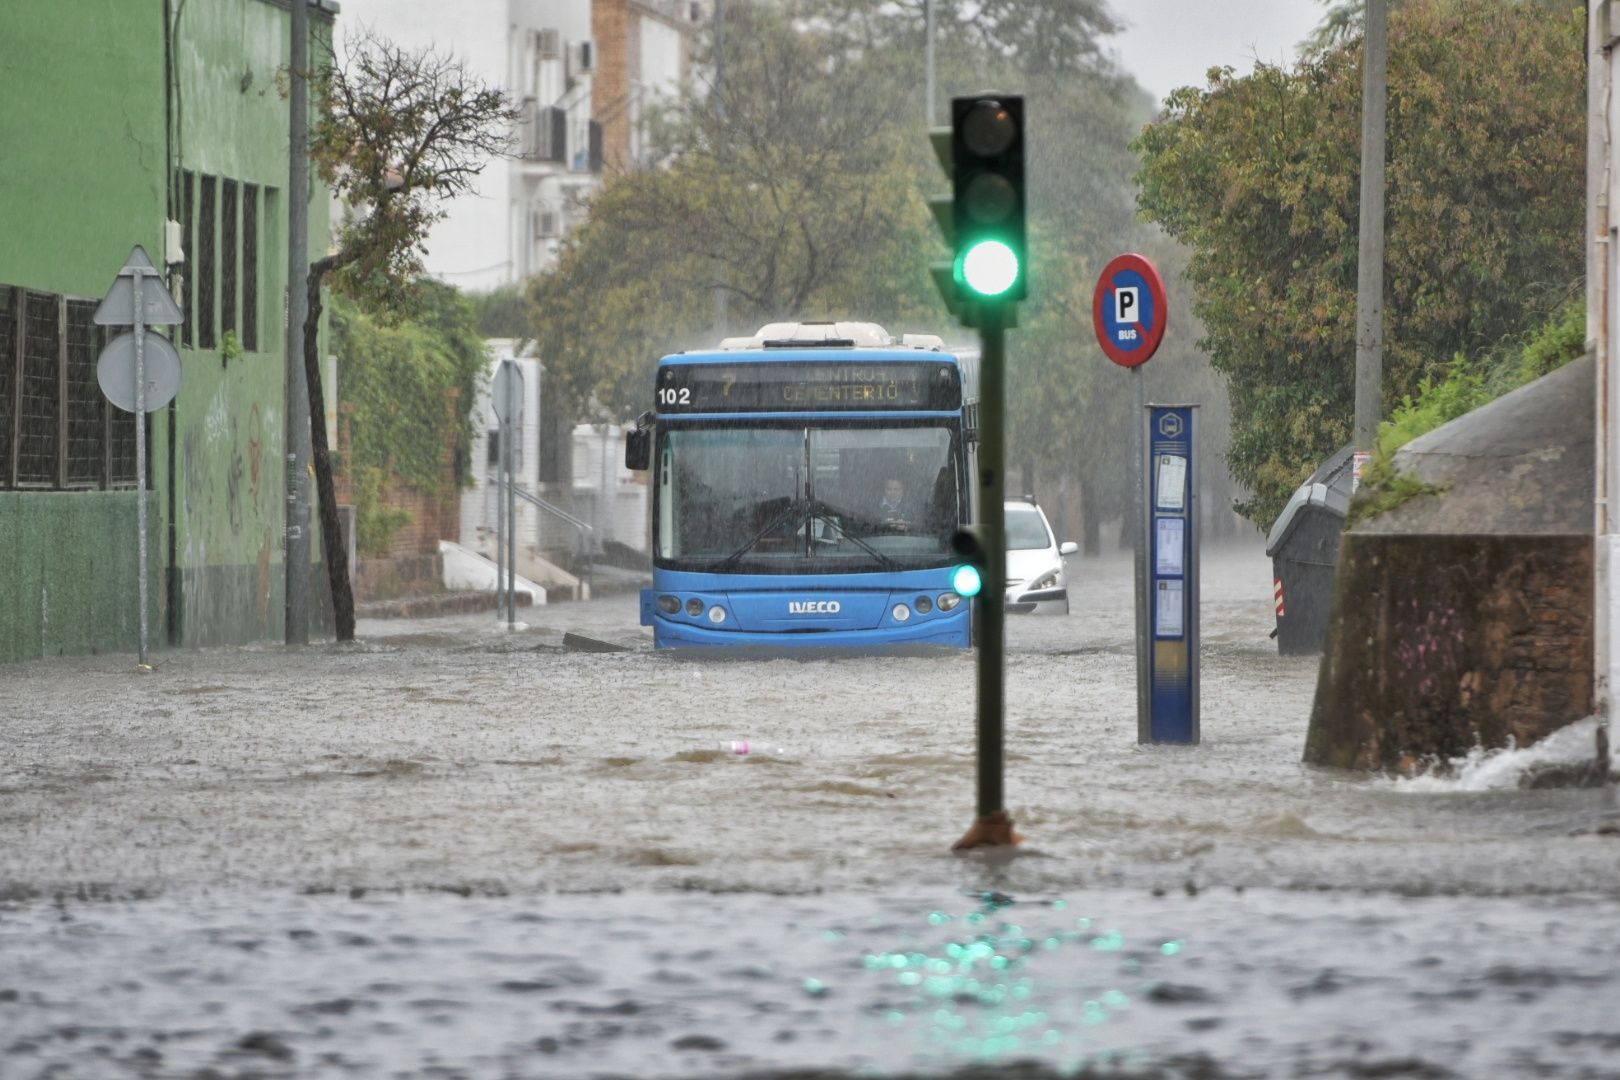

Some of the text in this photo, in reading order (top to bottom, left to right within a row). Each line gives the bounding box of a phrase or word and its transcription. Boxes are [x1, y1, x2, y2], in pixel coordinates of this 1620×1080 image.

[1119, 291, 1134, 319] P
[1118, 329, 1138, 340] BUS
[658, 387, 691, 405] 102
[783, 384, 898, 400] CEENTERIO
[788, 601, 841, 614] IVECO
